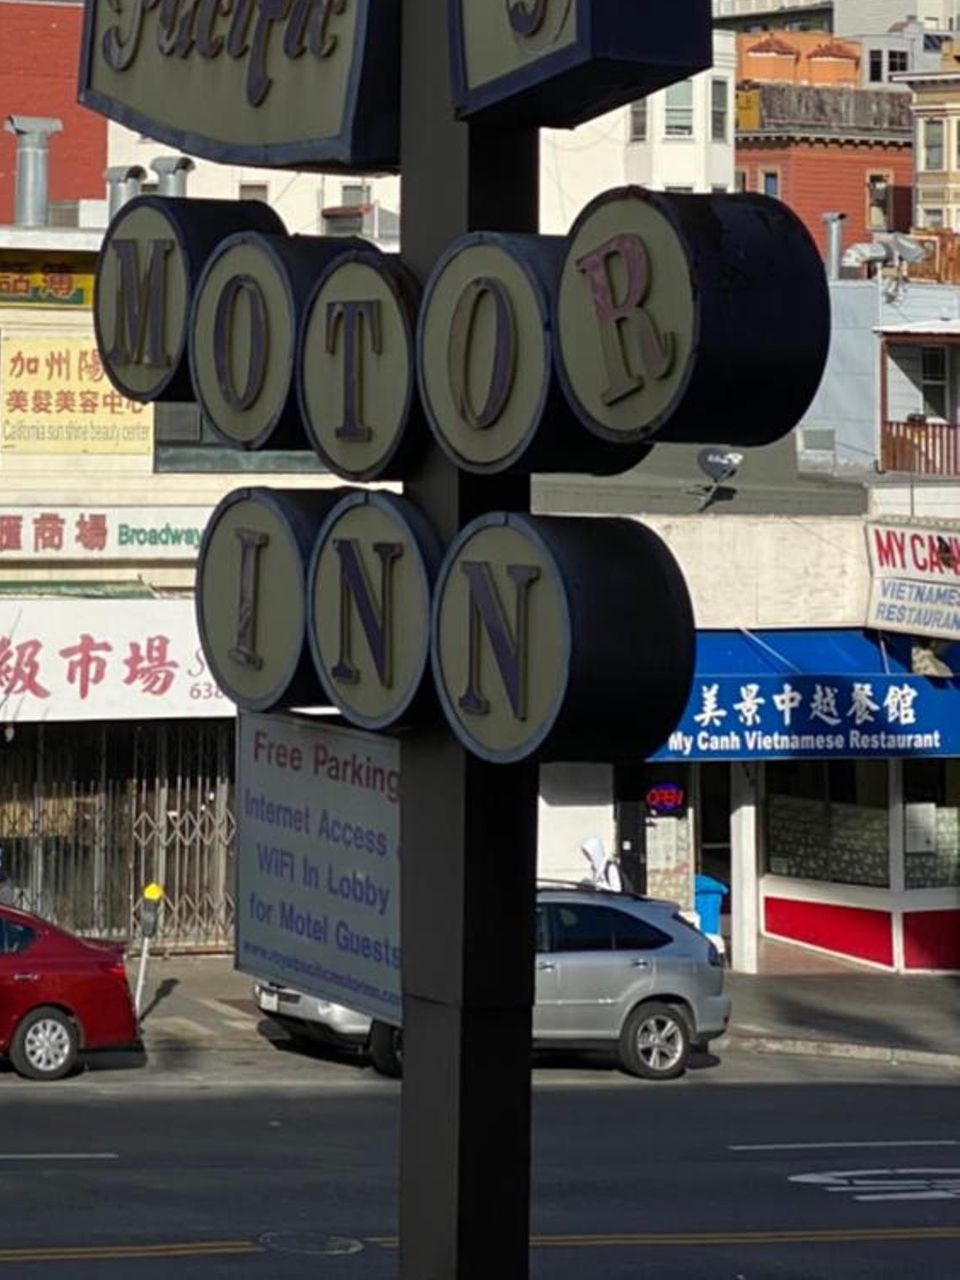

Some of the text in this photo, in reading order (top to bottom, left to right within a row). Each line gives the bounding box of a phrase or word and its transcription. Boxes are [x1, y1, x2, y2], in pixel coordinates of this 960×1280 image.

[108, 233, 677, 443] MOTOR
[117, 524, 203, 550] Broadway
[875, 528, 907, 570] MY
[231, 528, 542, 724] INN
[693, 683, 918, 726] 美景中越餐館
[253, 730, 400, 804] Free Parking
[668, 730, 941, 754] My Canh Vietnamese Restaurant
[245, 788, 388, 856] Internet Access
[327, 863, 390, 916] Lobby
[249, 890, 402, 970] for Motel Guests
